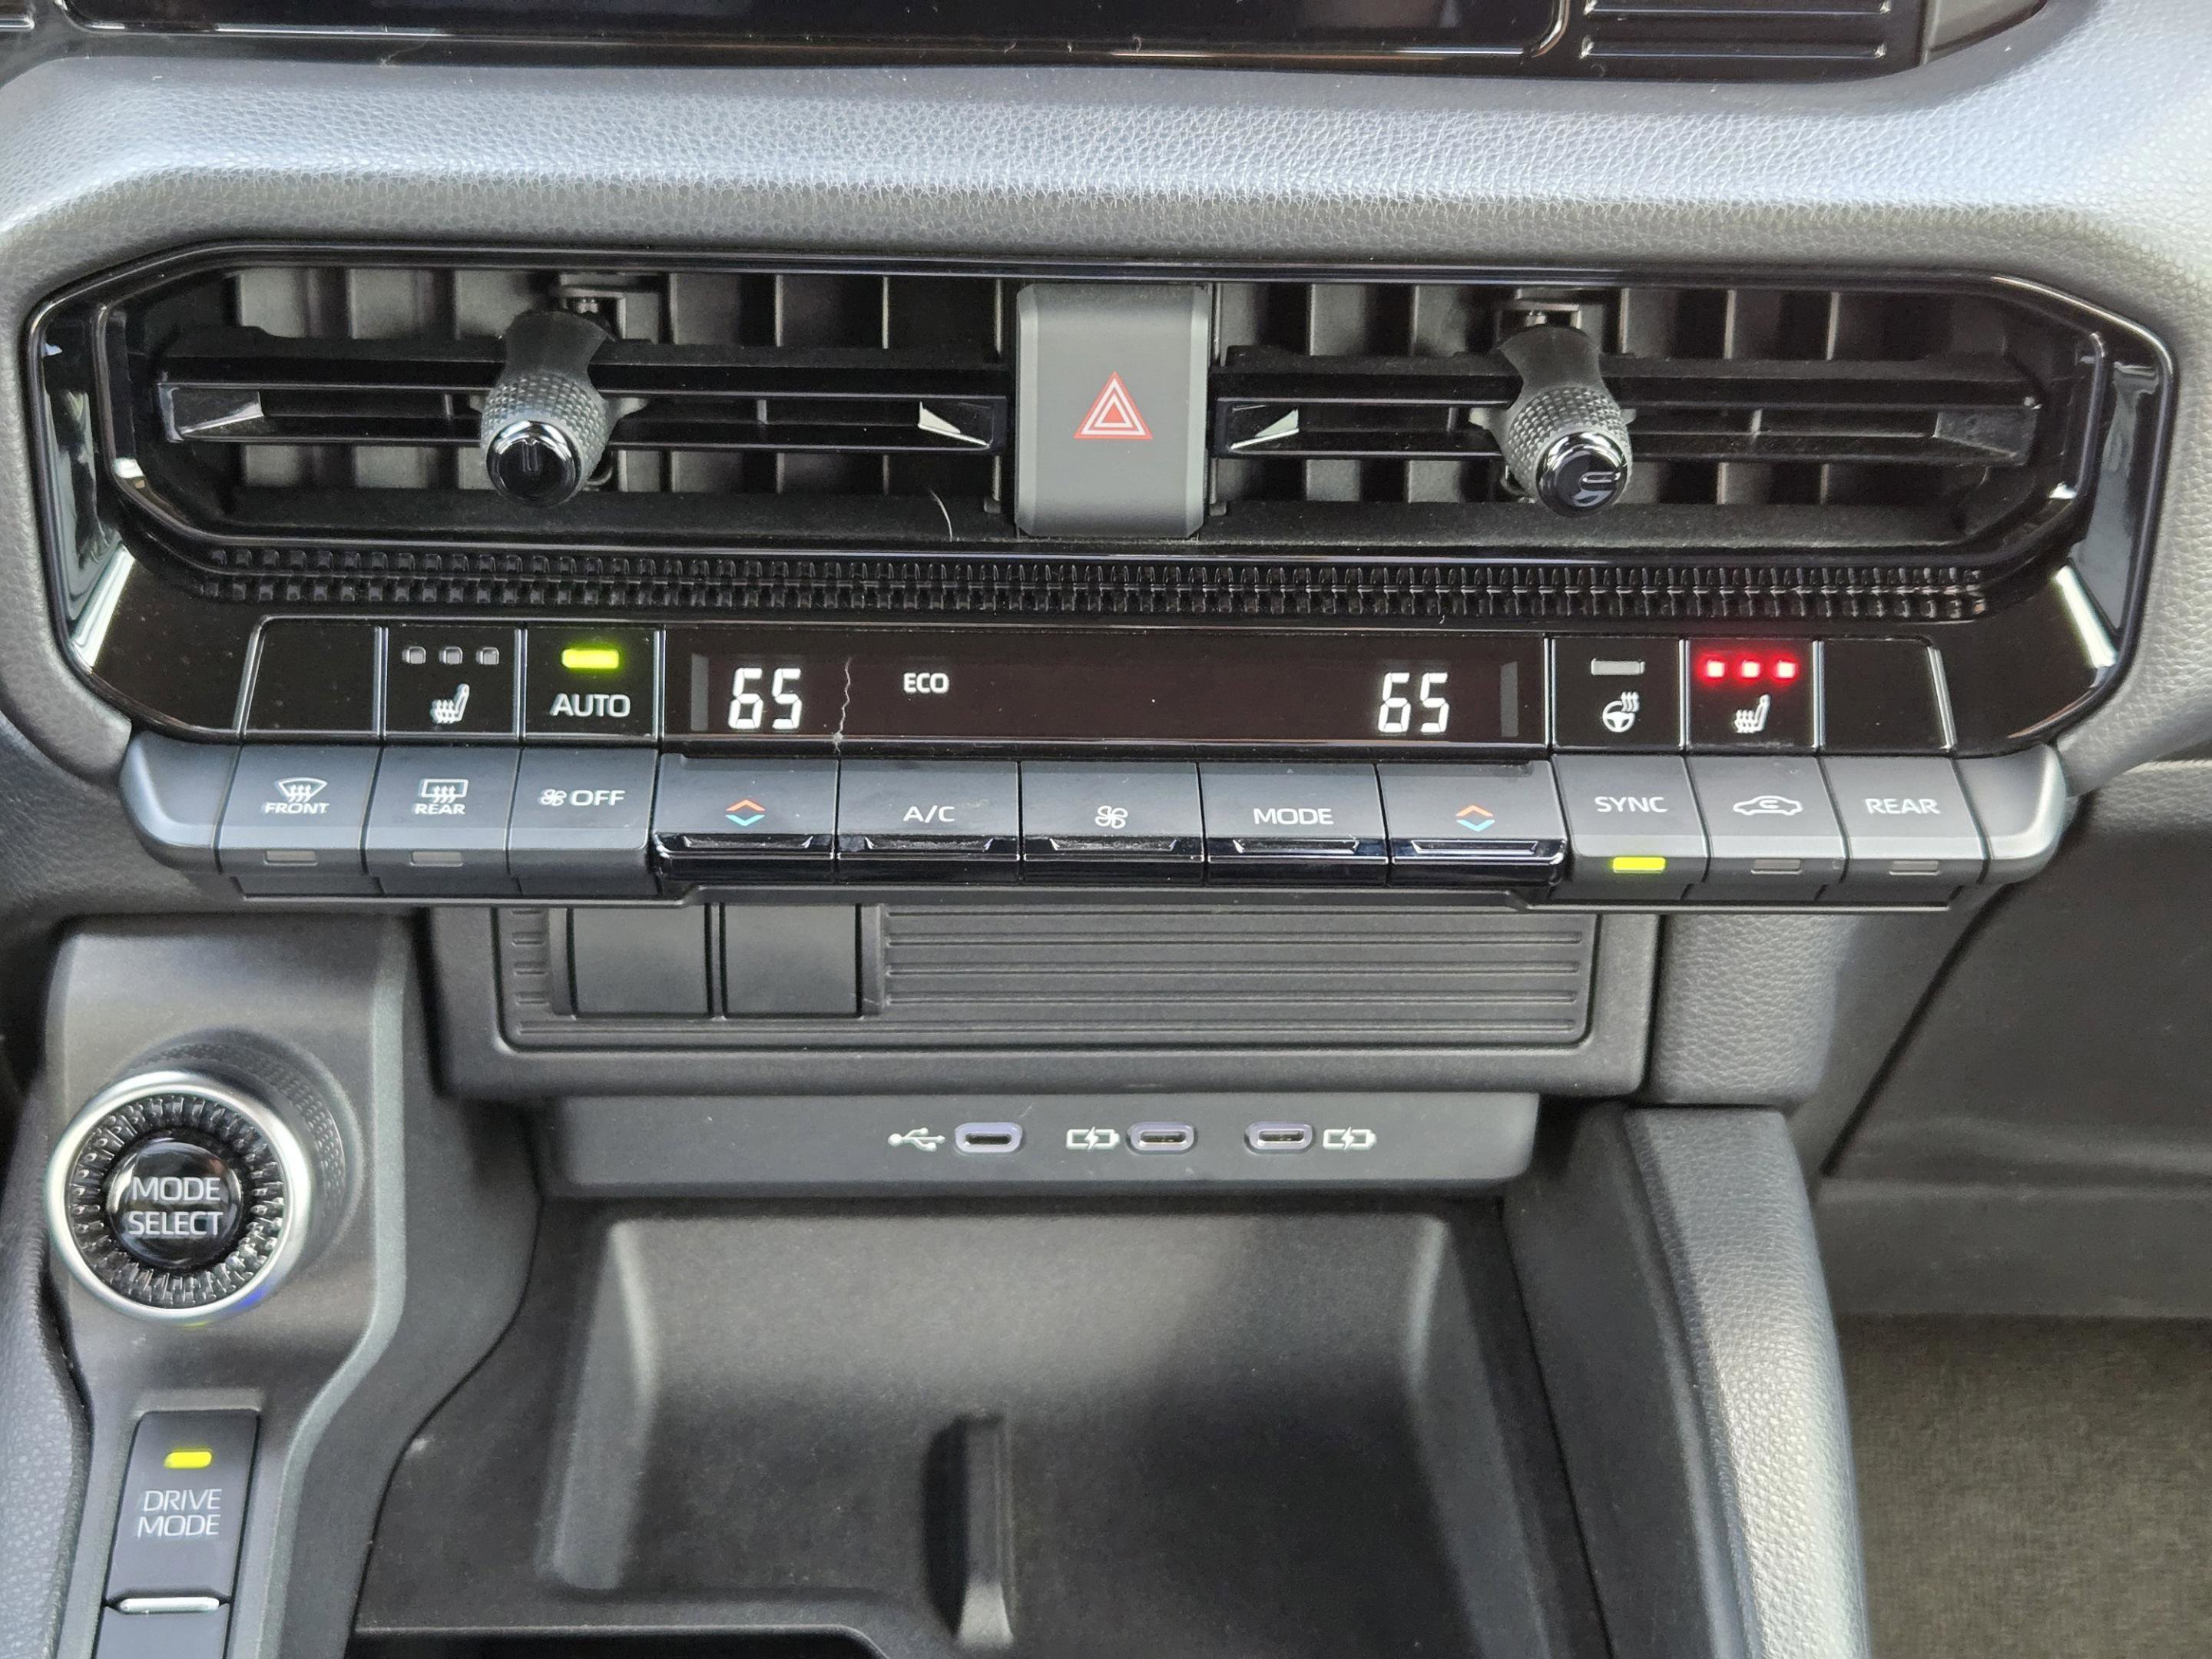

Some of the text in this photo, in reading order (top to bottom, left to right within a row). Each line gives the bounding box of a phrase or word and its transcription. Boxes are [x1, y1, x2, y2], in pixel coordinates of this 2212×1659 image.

[903, 672, 949, 693] ECO
[549, 694, 631, 717] AUTO
[728, 667, 802, 730] 65
[1378, 672, 1449, 733] 65
[263, 802, 330, 815] FRONT
[570, 790, 626, 806] OFF
[1594, 796, 1668, 813] SYNC
[1866, 797, 1941, 815] REAR
[414, 802, 466, 816] REAR
[902, 805, 955, 823] A/C
[1253, 808, 1334, 826] MODE
[130, 1177, 221, 1203] MODE
[127, 1210, 225, 1237] SELECT
[143, 1488, 224, 1512] DRIVE
[137, 1514, 221, 1538] MODE
